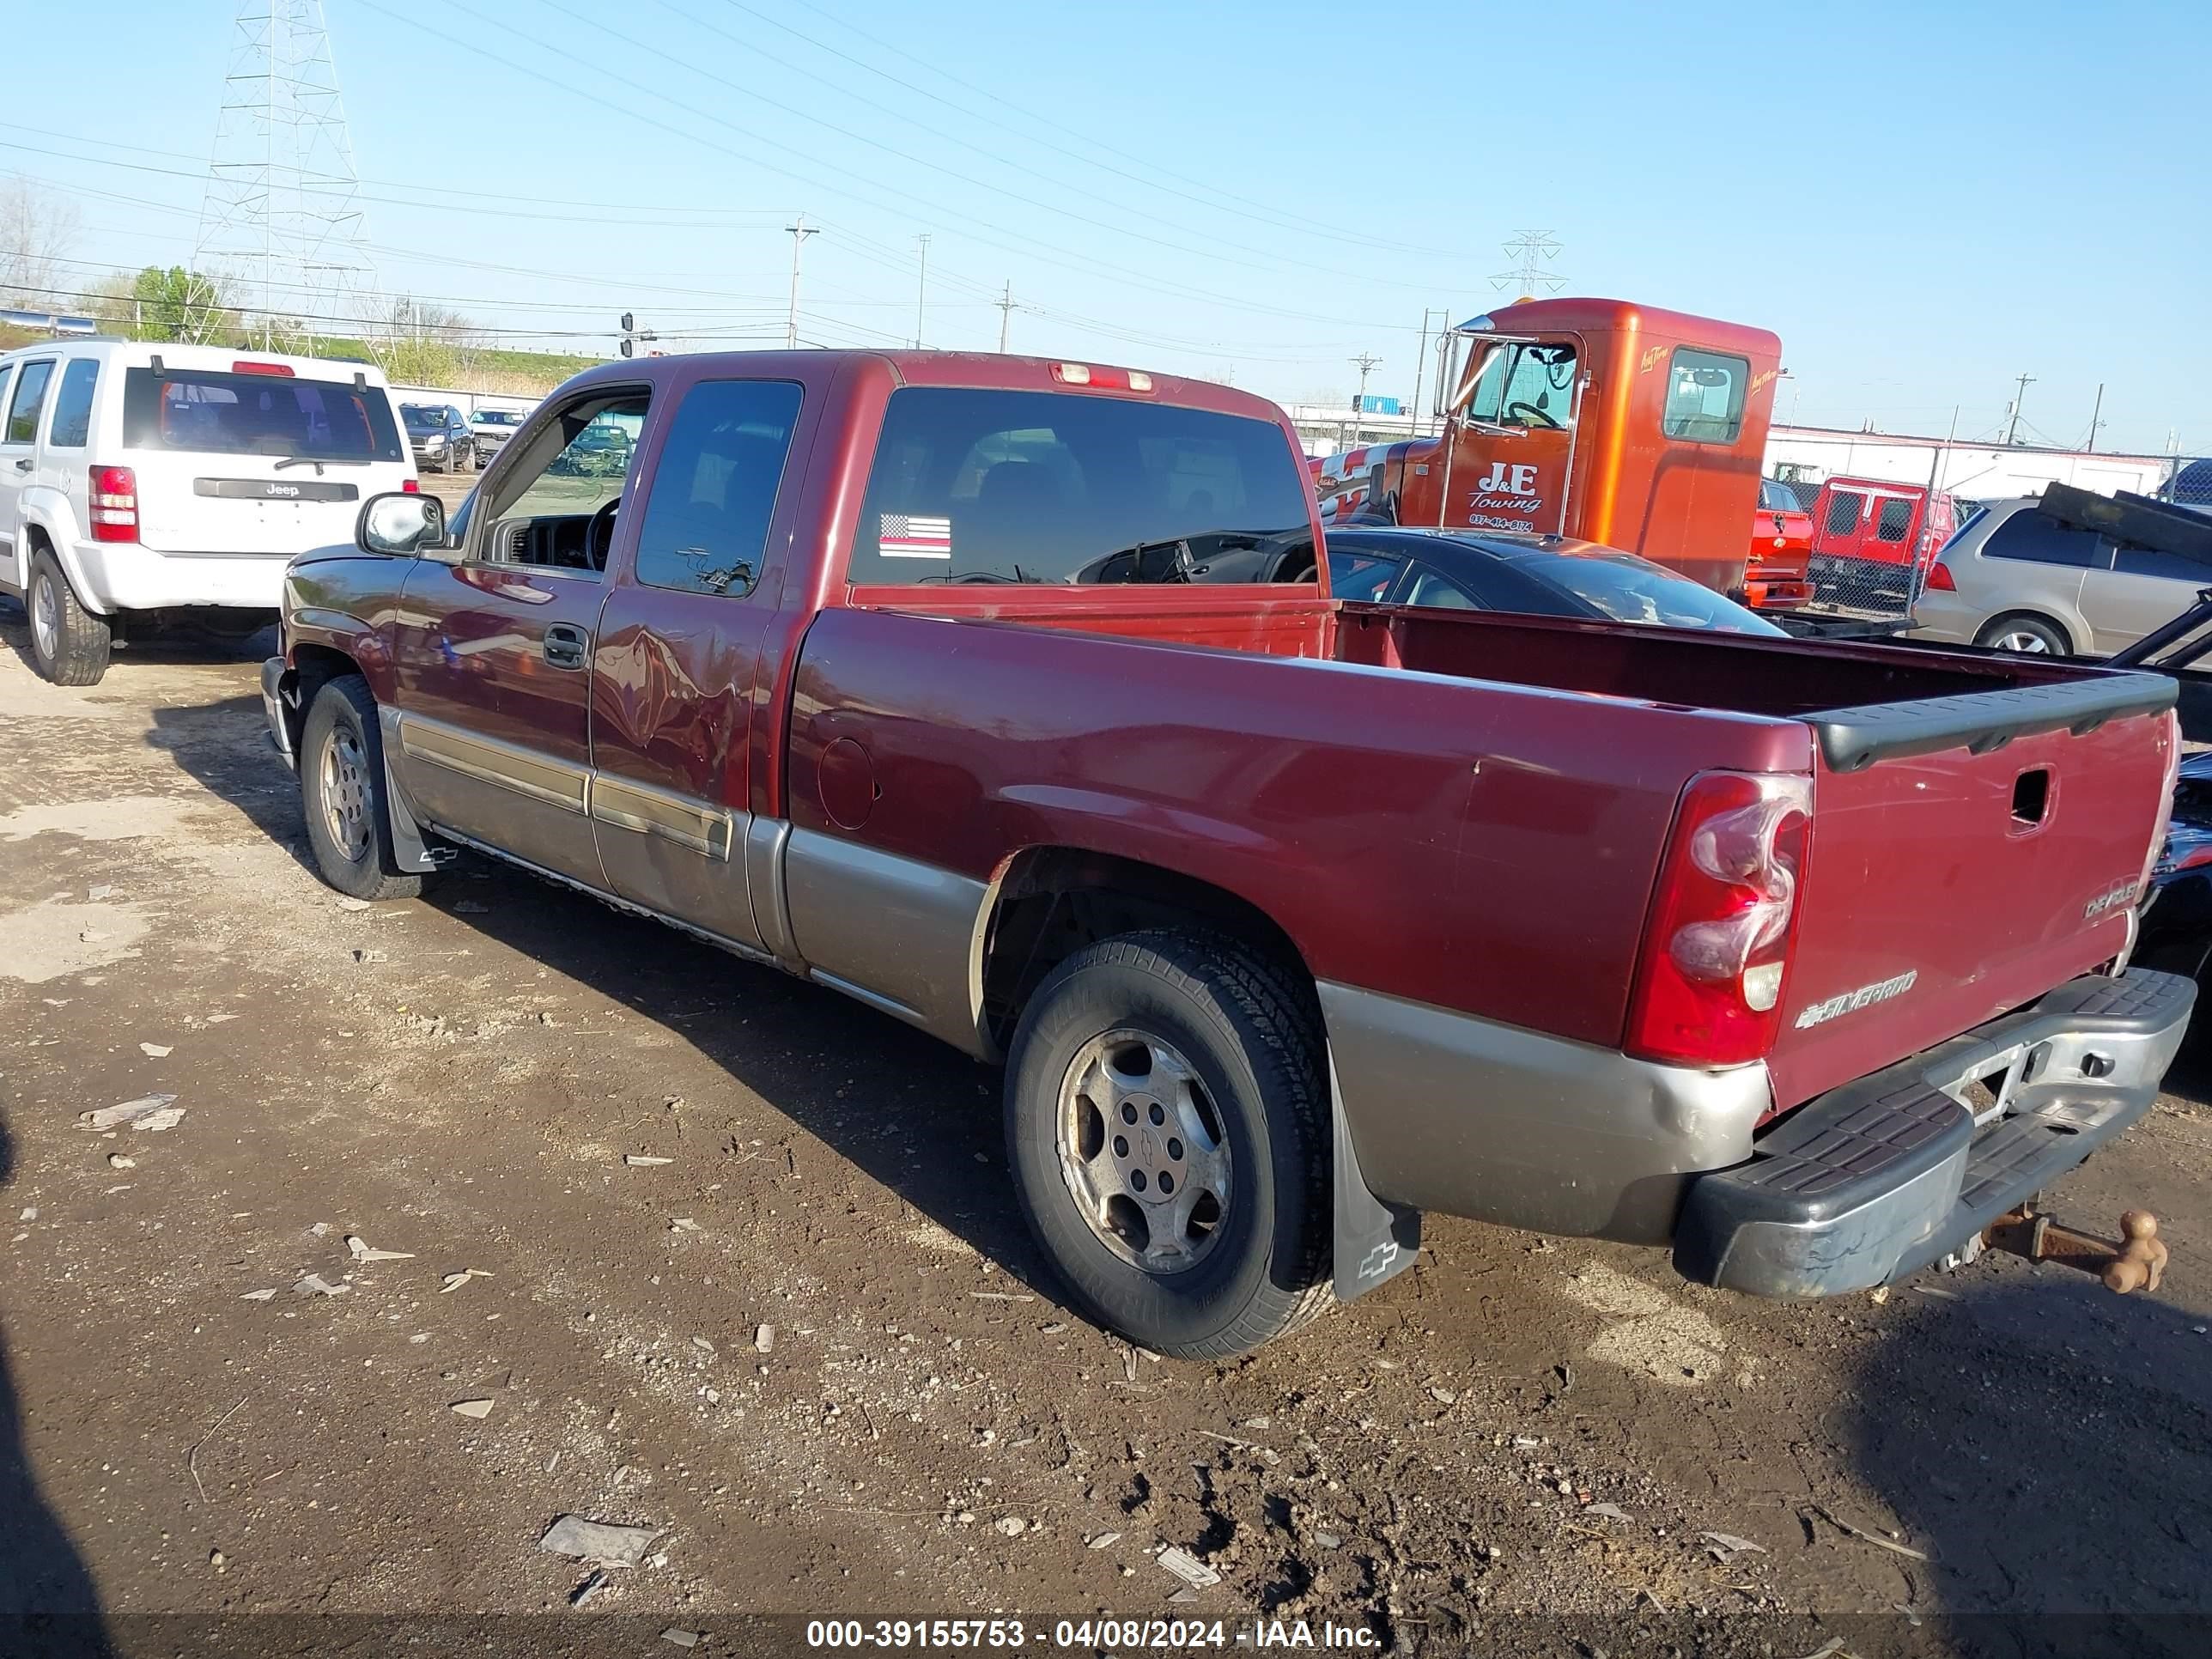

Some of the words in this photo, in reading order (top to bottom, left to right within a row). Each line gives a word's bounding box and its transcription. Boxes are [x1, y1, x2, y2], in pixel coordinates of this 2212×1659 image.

[1478, 462, 1538, 495] J&E
[266, 483, 300, 497] Jeep
[1468, 492, 1542, 514] Towing
[1469, 514, 1533, 532] 937-414-8174
[1818, 969, 1917, 1024] SILVERADO
